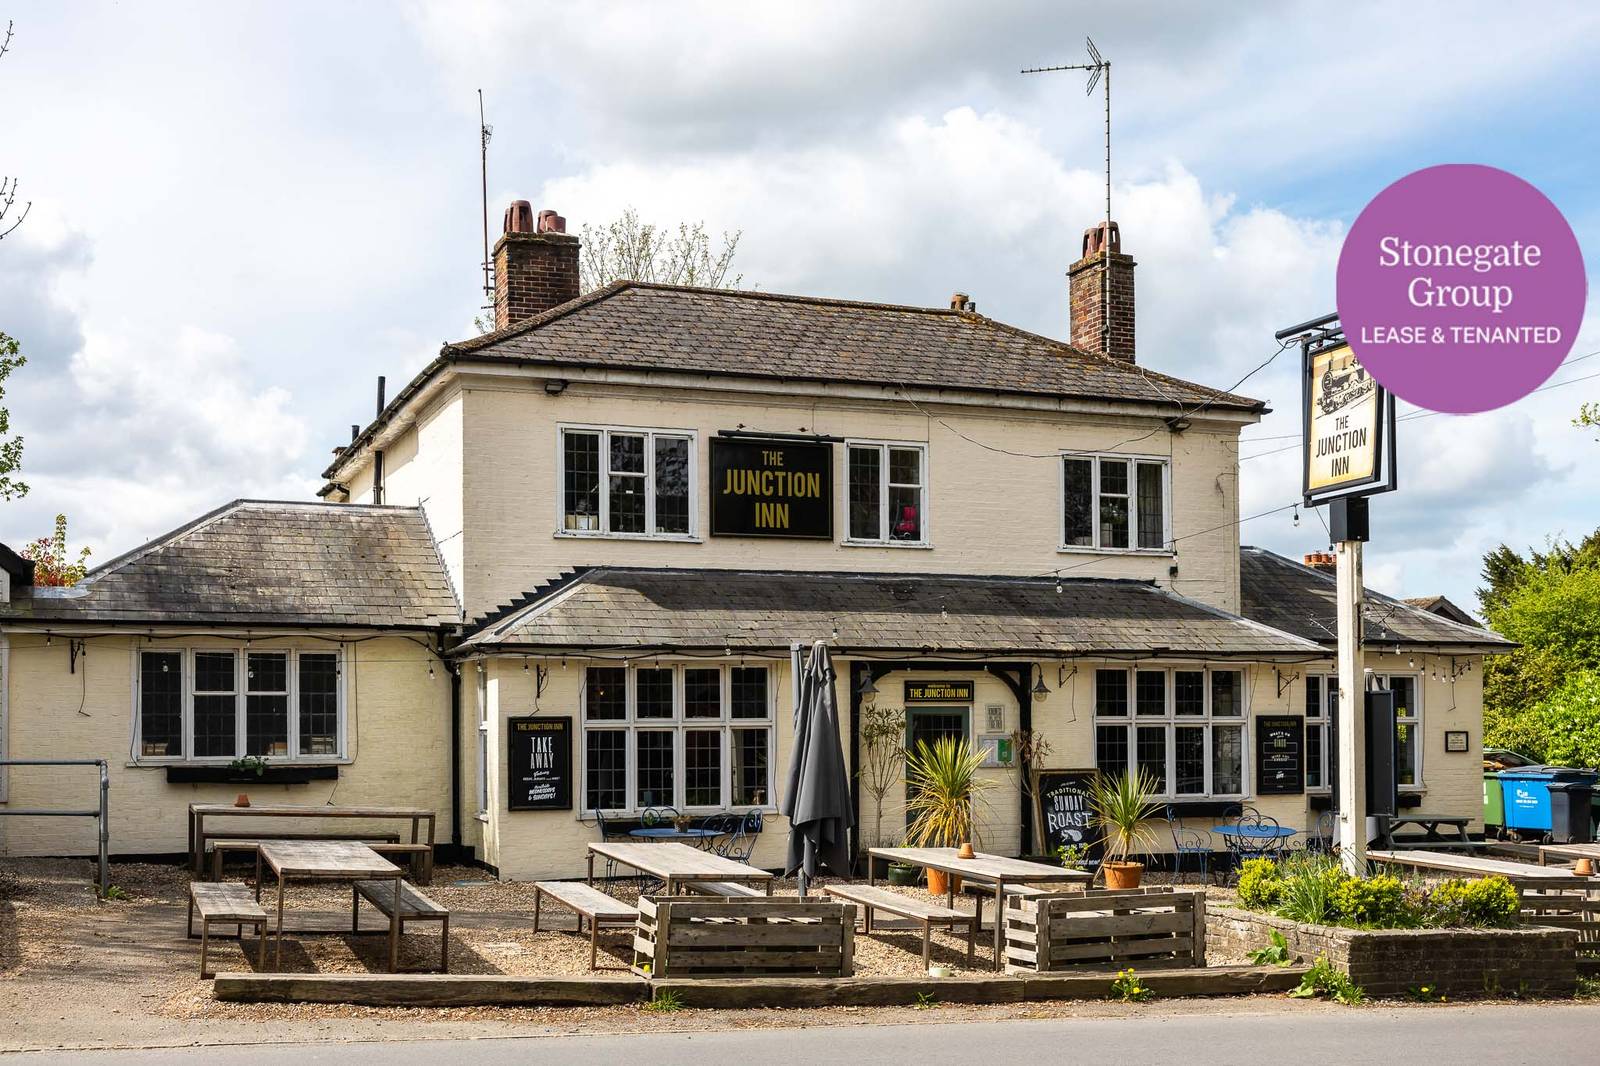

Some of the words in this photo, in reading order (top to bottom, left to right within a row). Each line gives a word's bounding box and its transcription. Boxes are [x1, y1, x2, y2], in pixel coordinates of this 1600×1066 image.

[1335, 415, 1349, 431] THE
[1316, 427, 1367, 458] JUNCTION
[762, 450, 784, 466] THE
[1331, 456, 1350, 477] INN
[723, 469, 820, 498] JUNCTION
[755, 502, 789, 528] INN
[910, 688, 922, 698] THE
[924, 688, 956, 698] JUNCTION
[956, 688, 968, 698] INN
[531, 737, 552, 753] TAKE
[530, 753, 554, 769] AWAY
[1047, 788, 1089, 798] TRADITIONAL
[1054, 795, 1082, 811] SUNDAY
[1048, 812, 1092, 834] ROAST
